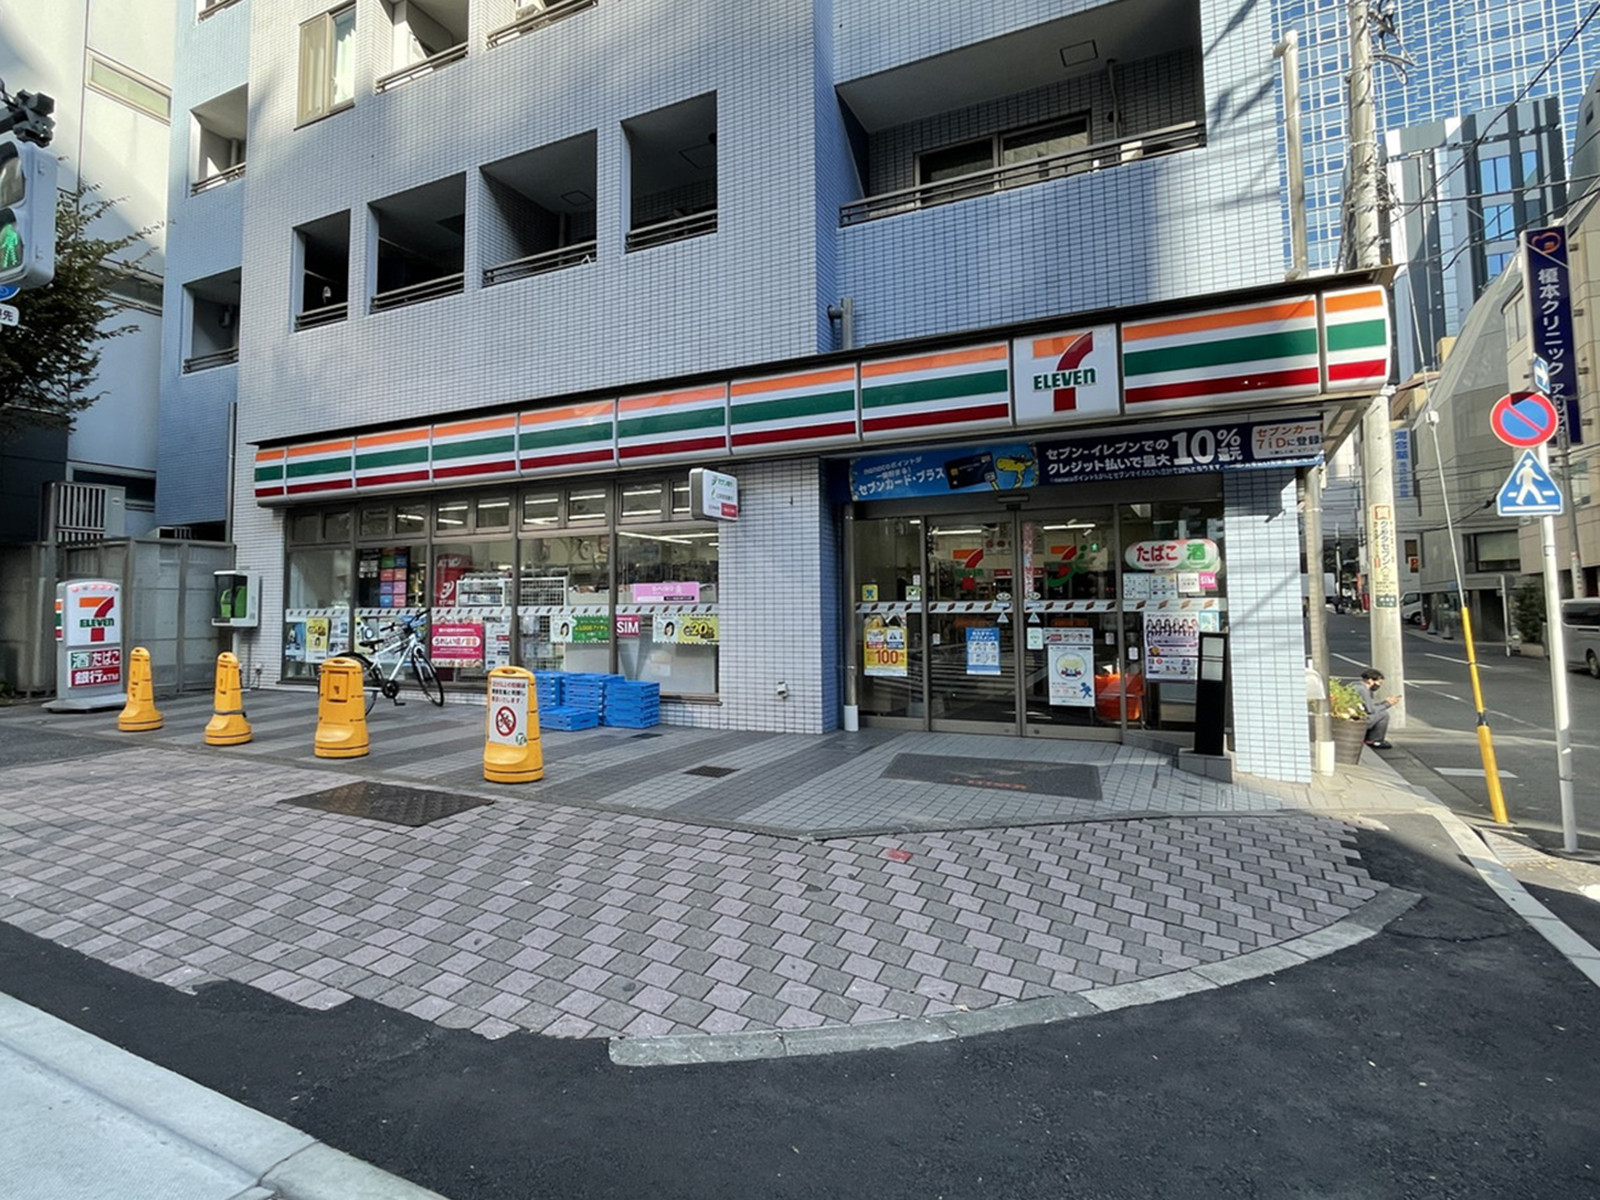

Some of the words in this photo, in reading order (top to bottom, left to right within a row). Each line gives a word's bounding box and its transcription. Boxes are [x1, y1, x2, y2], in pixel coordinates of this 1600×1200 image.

[1047, 453, 1172, 475] クレジット払いで最大
[1136, 544, 1178, 562] たばこ
[1187, 543, 1206, 561] 酒
[616, 621, 639, 634] SIM
[92, 651, 120, 667] たばこ
